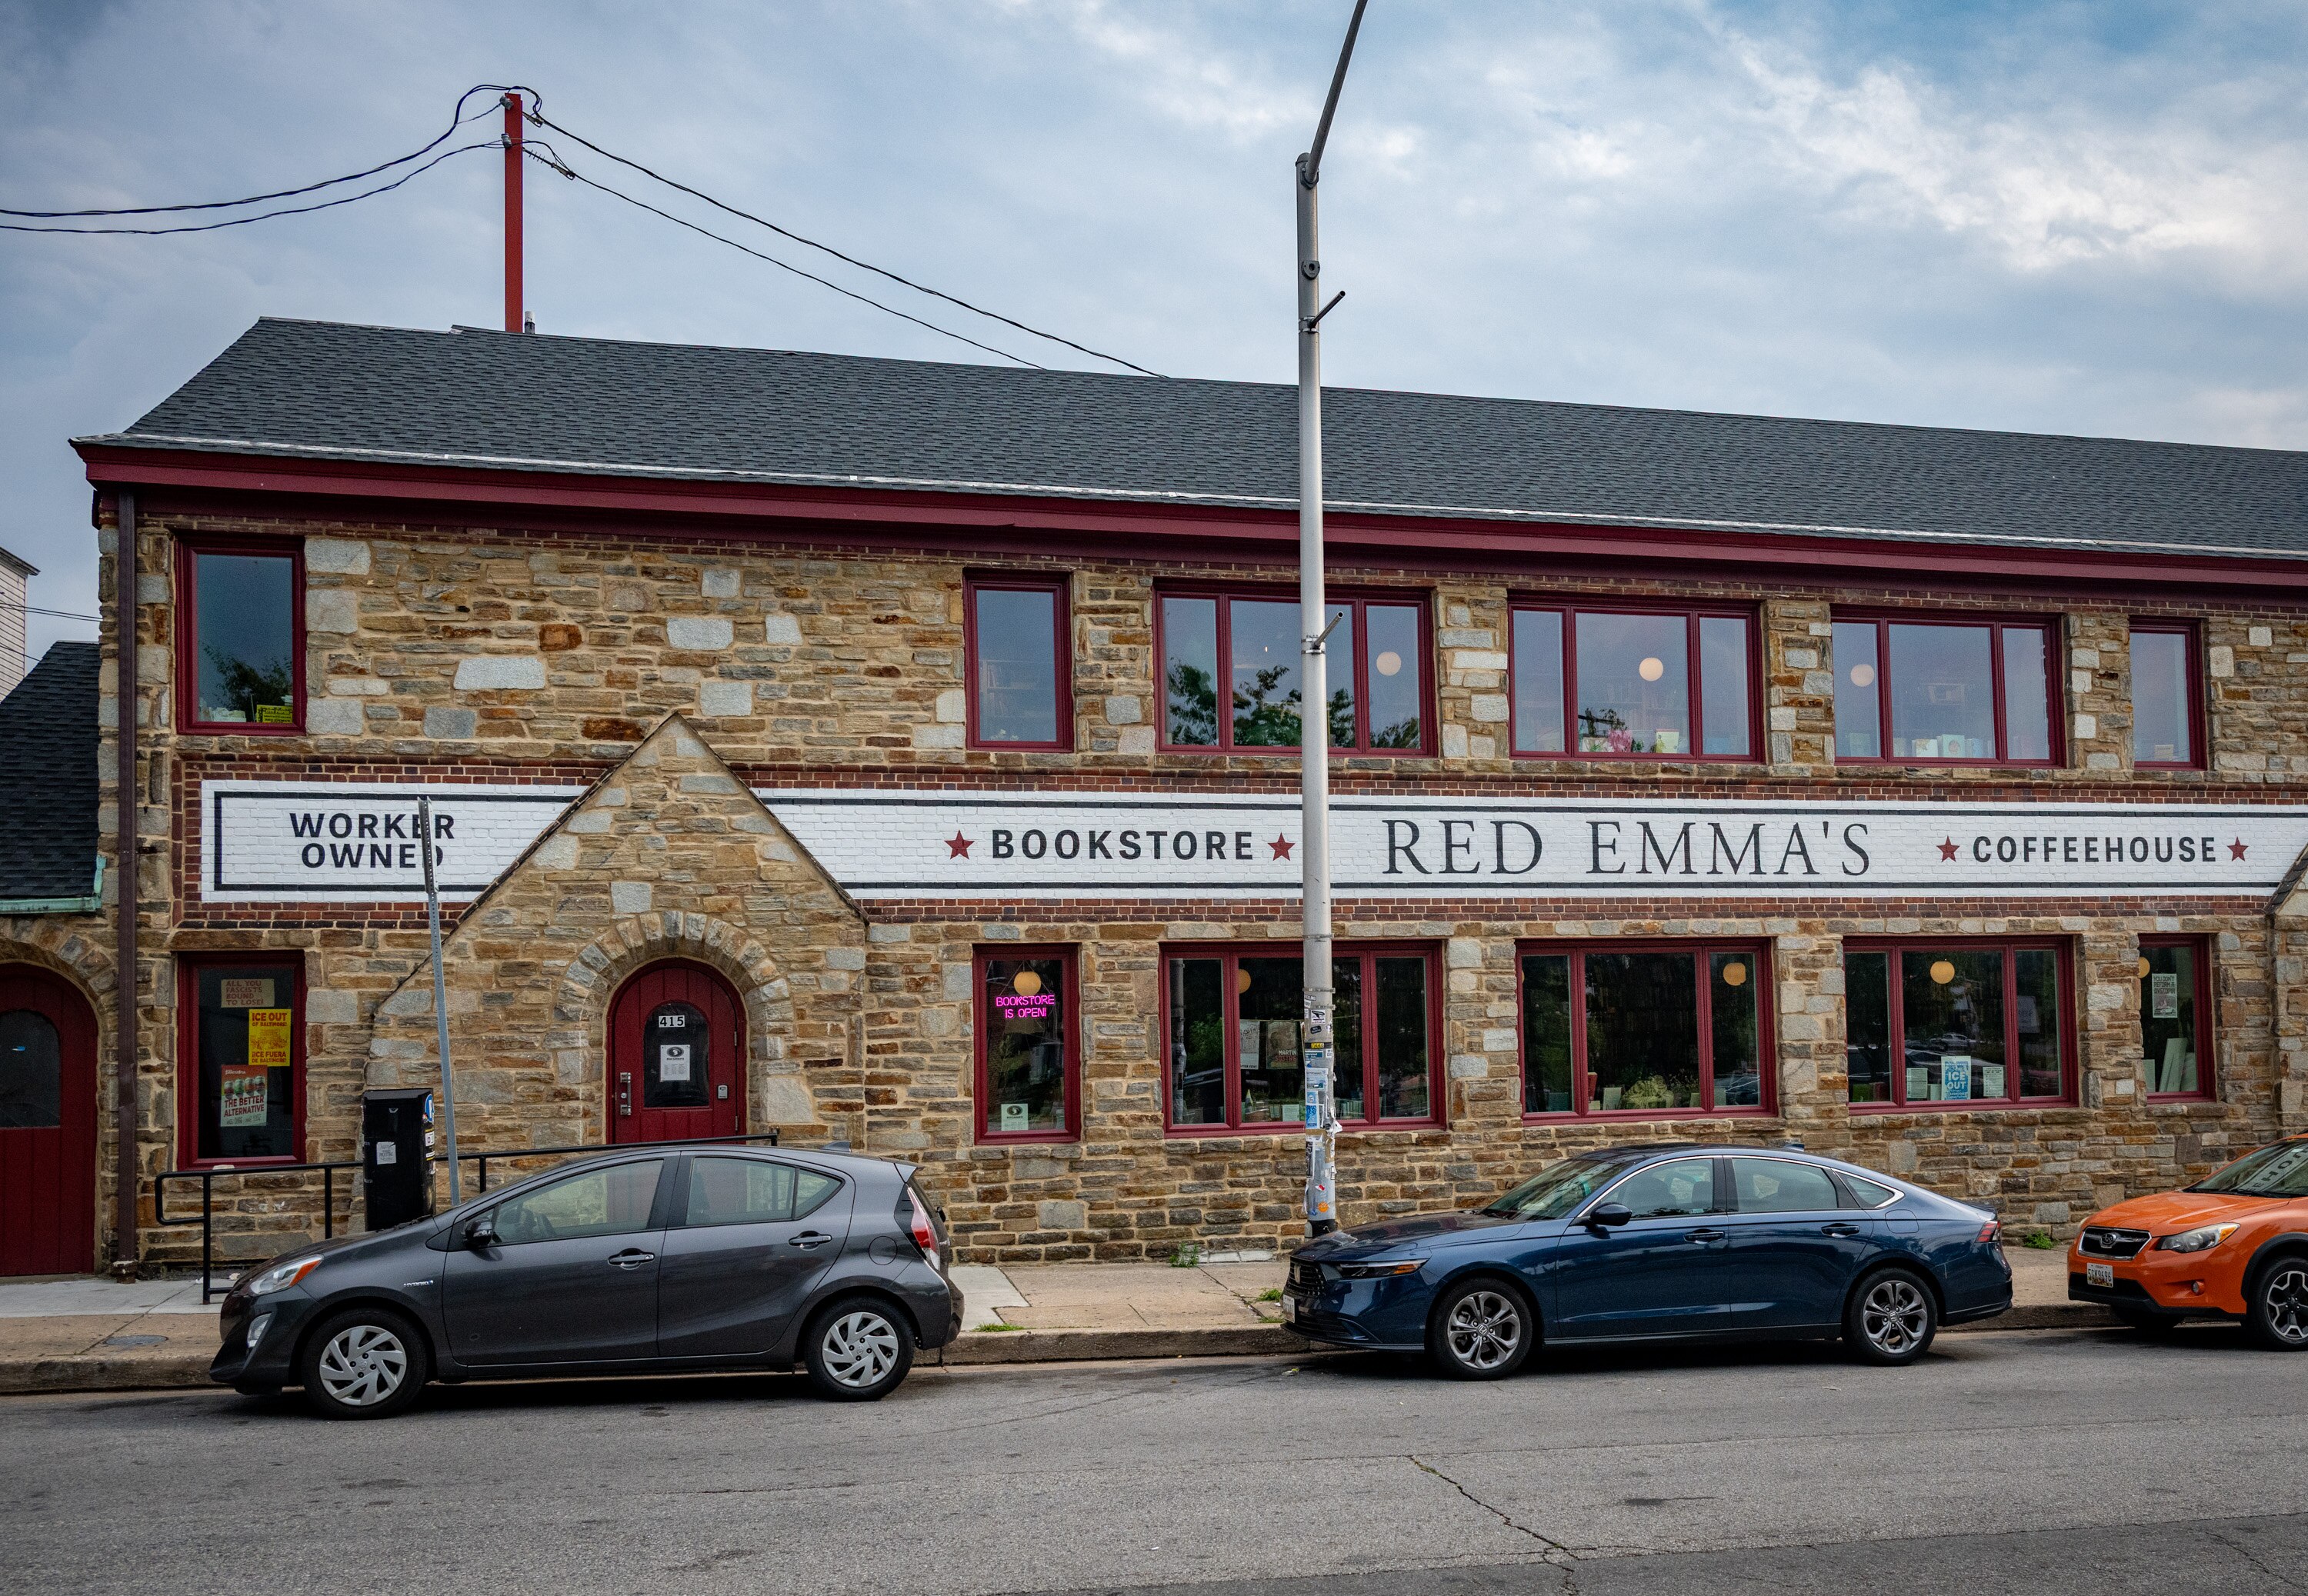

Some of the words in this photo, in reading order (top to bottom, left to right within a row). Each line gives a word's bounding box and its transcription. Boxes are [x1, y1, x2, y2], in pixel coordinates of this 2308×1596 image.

[992, 830, 1252, 860] BOOKSTORE
[1382, 819, 1543, 875] RED
[1586, 821, 1869, 876] EMMA'S
[1973, 836, 2216, 863] COFFEEHOUSE
[996, 995, 1055, 1007] BOOKSTORE
[252, 1012, 266, 1021] ICE
[268, 1012, 287, 1021] OUT
[1005, 1008, 1014, 1018] IS
[1018, 1008, 1047, 1018] OPEN!
[659, 1016, 684, 1027] 415
[1948, 1071, 1966, 1081] ICE
[1946, 1081, 1966, 1090] OUT
[224, 1098, 238, 1108] THE
[238, 1095, 264, 1107] BETTER
[223, 1105, 265, 1117] ALTERNATIVE
